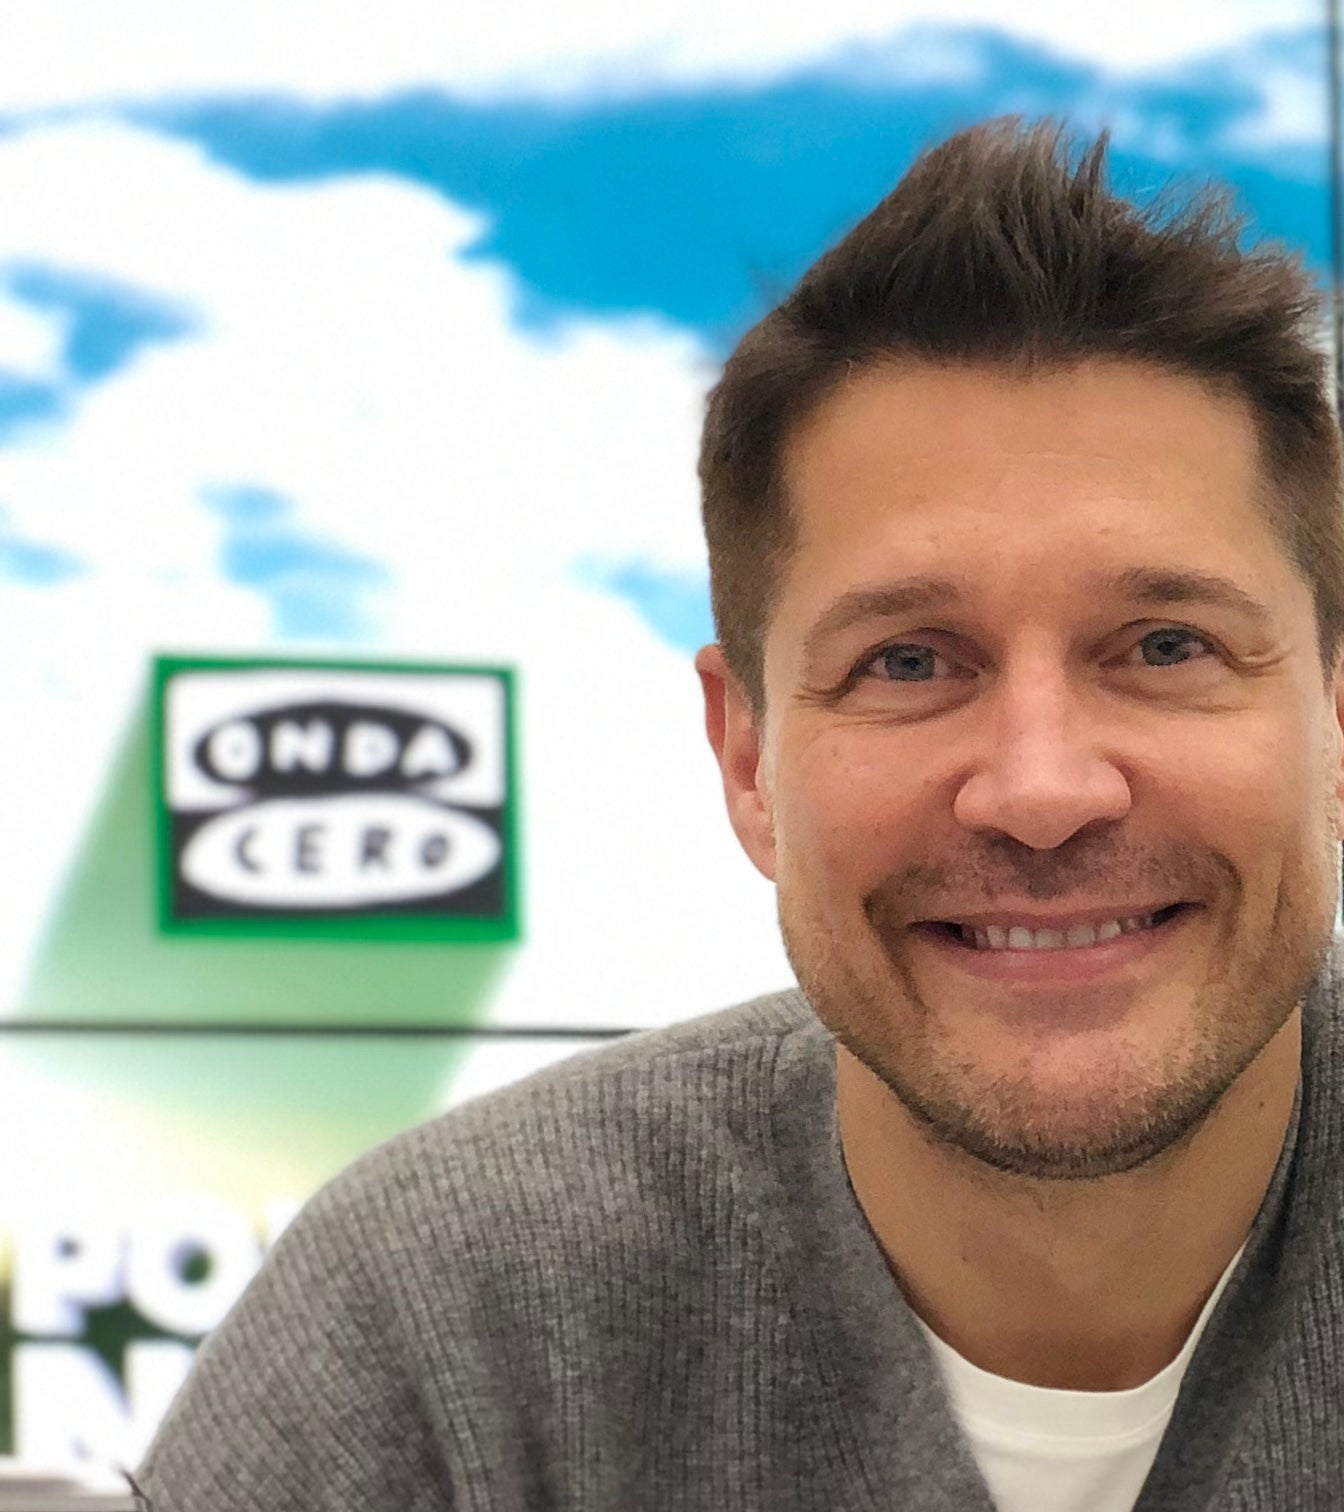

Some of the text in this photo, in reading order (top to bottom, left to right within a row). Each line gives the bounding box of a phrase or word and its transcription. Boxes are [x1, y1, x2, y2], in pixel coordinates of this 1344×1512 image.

[207, 719, 459, 782] ONDA
[233, 822, 452, 874] CERO
[14, 1196, 304, 1332] PO
